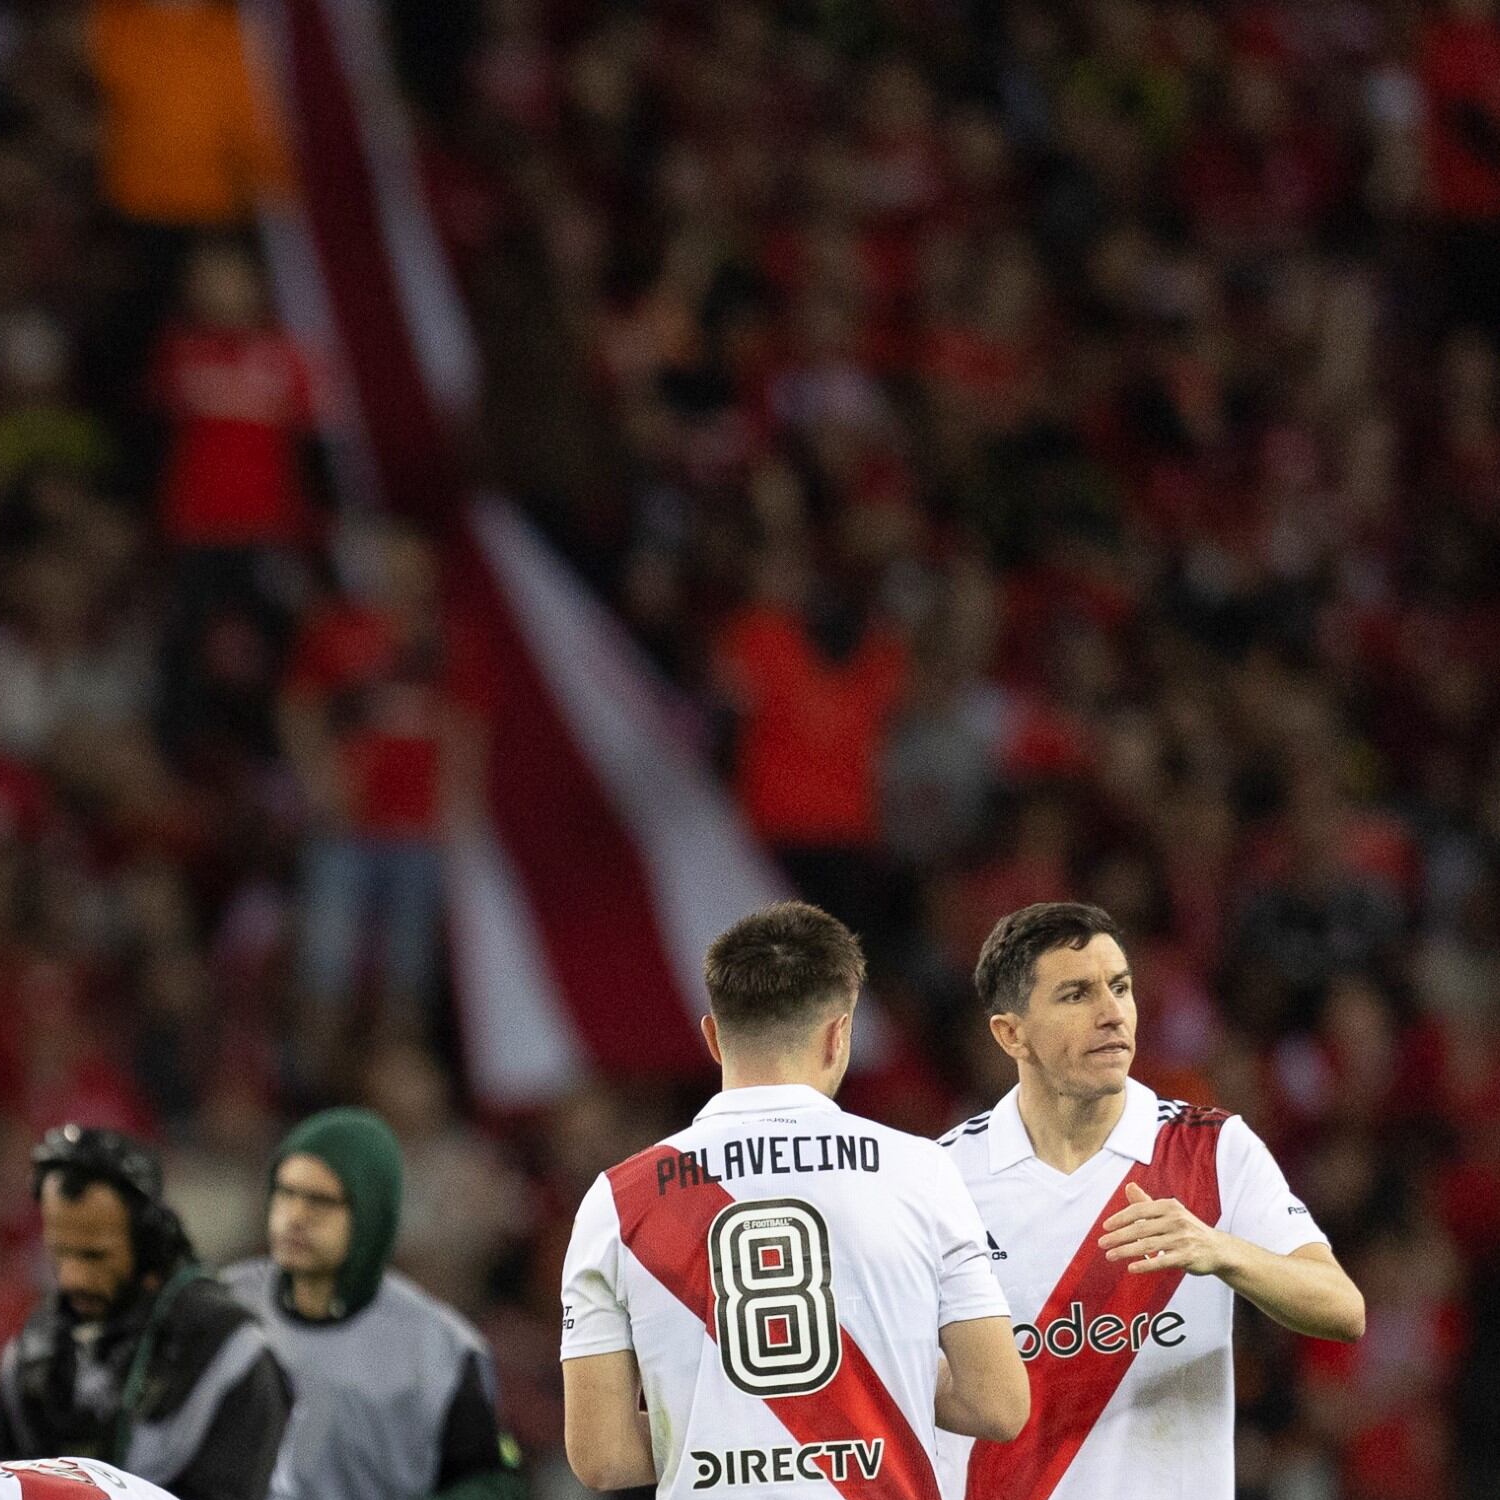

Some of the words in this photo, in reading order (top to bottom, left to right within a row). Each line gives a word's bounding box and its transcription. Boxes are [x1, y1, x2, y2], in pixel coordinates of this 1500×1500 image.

[656, 1134, 880, 1196] PALAVECINO
[707, 1198, 843, 1399] 8
[1012, 1301, 1188, 1361] odere
[690, 1438, 884, 1490] DIRECTV
